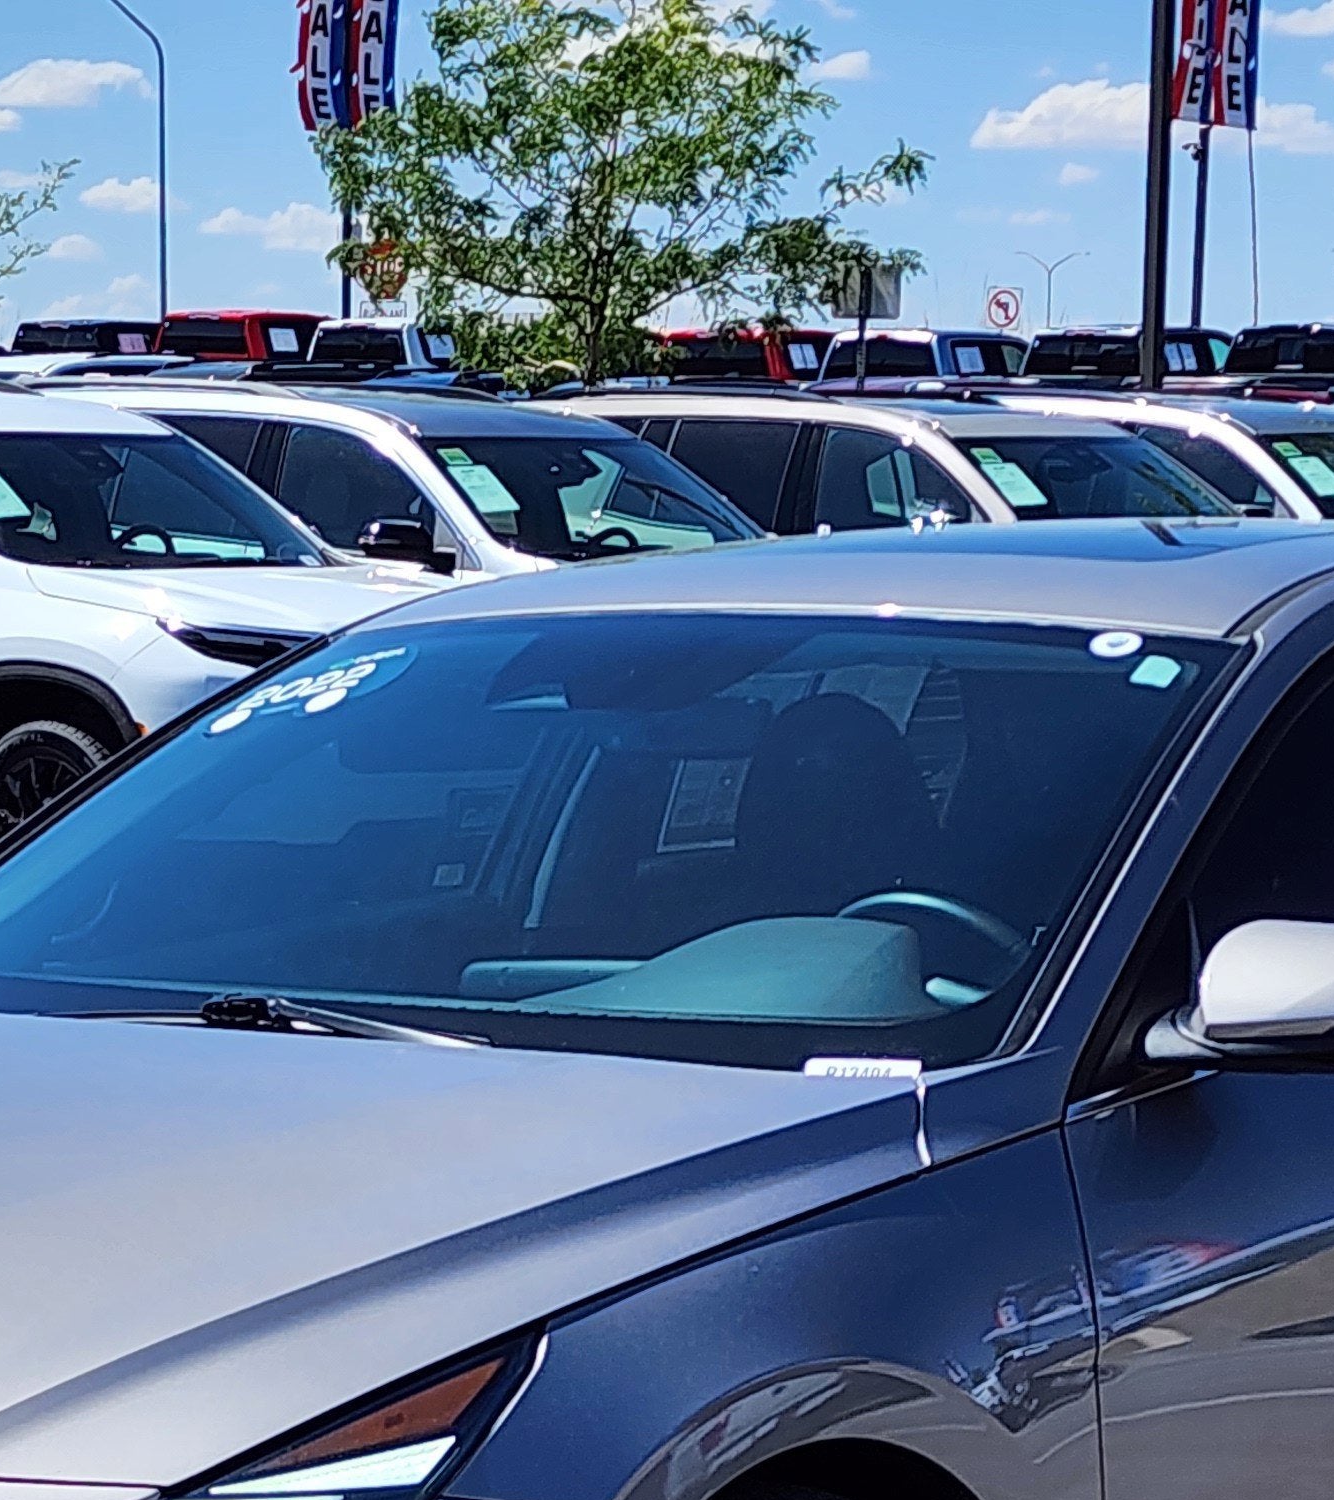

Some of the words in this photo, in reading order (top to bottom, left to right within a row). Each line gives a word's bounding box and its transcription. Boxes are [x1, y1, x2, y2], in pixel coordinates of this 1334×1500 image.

[311, 2, 331, 119] ALE
[362, 0, 383, 119] ALE
[235, 662, 377, 712] 2022
